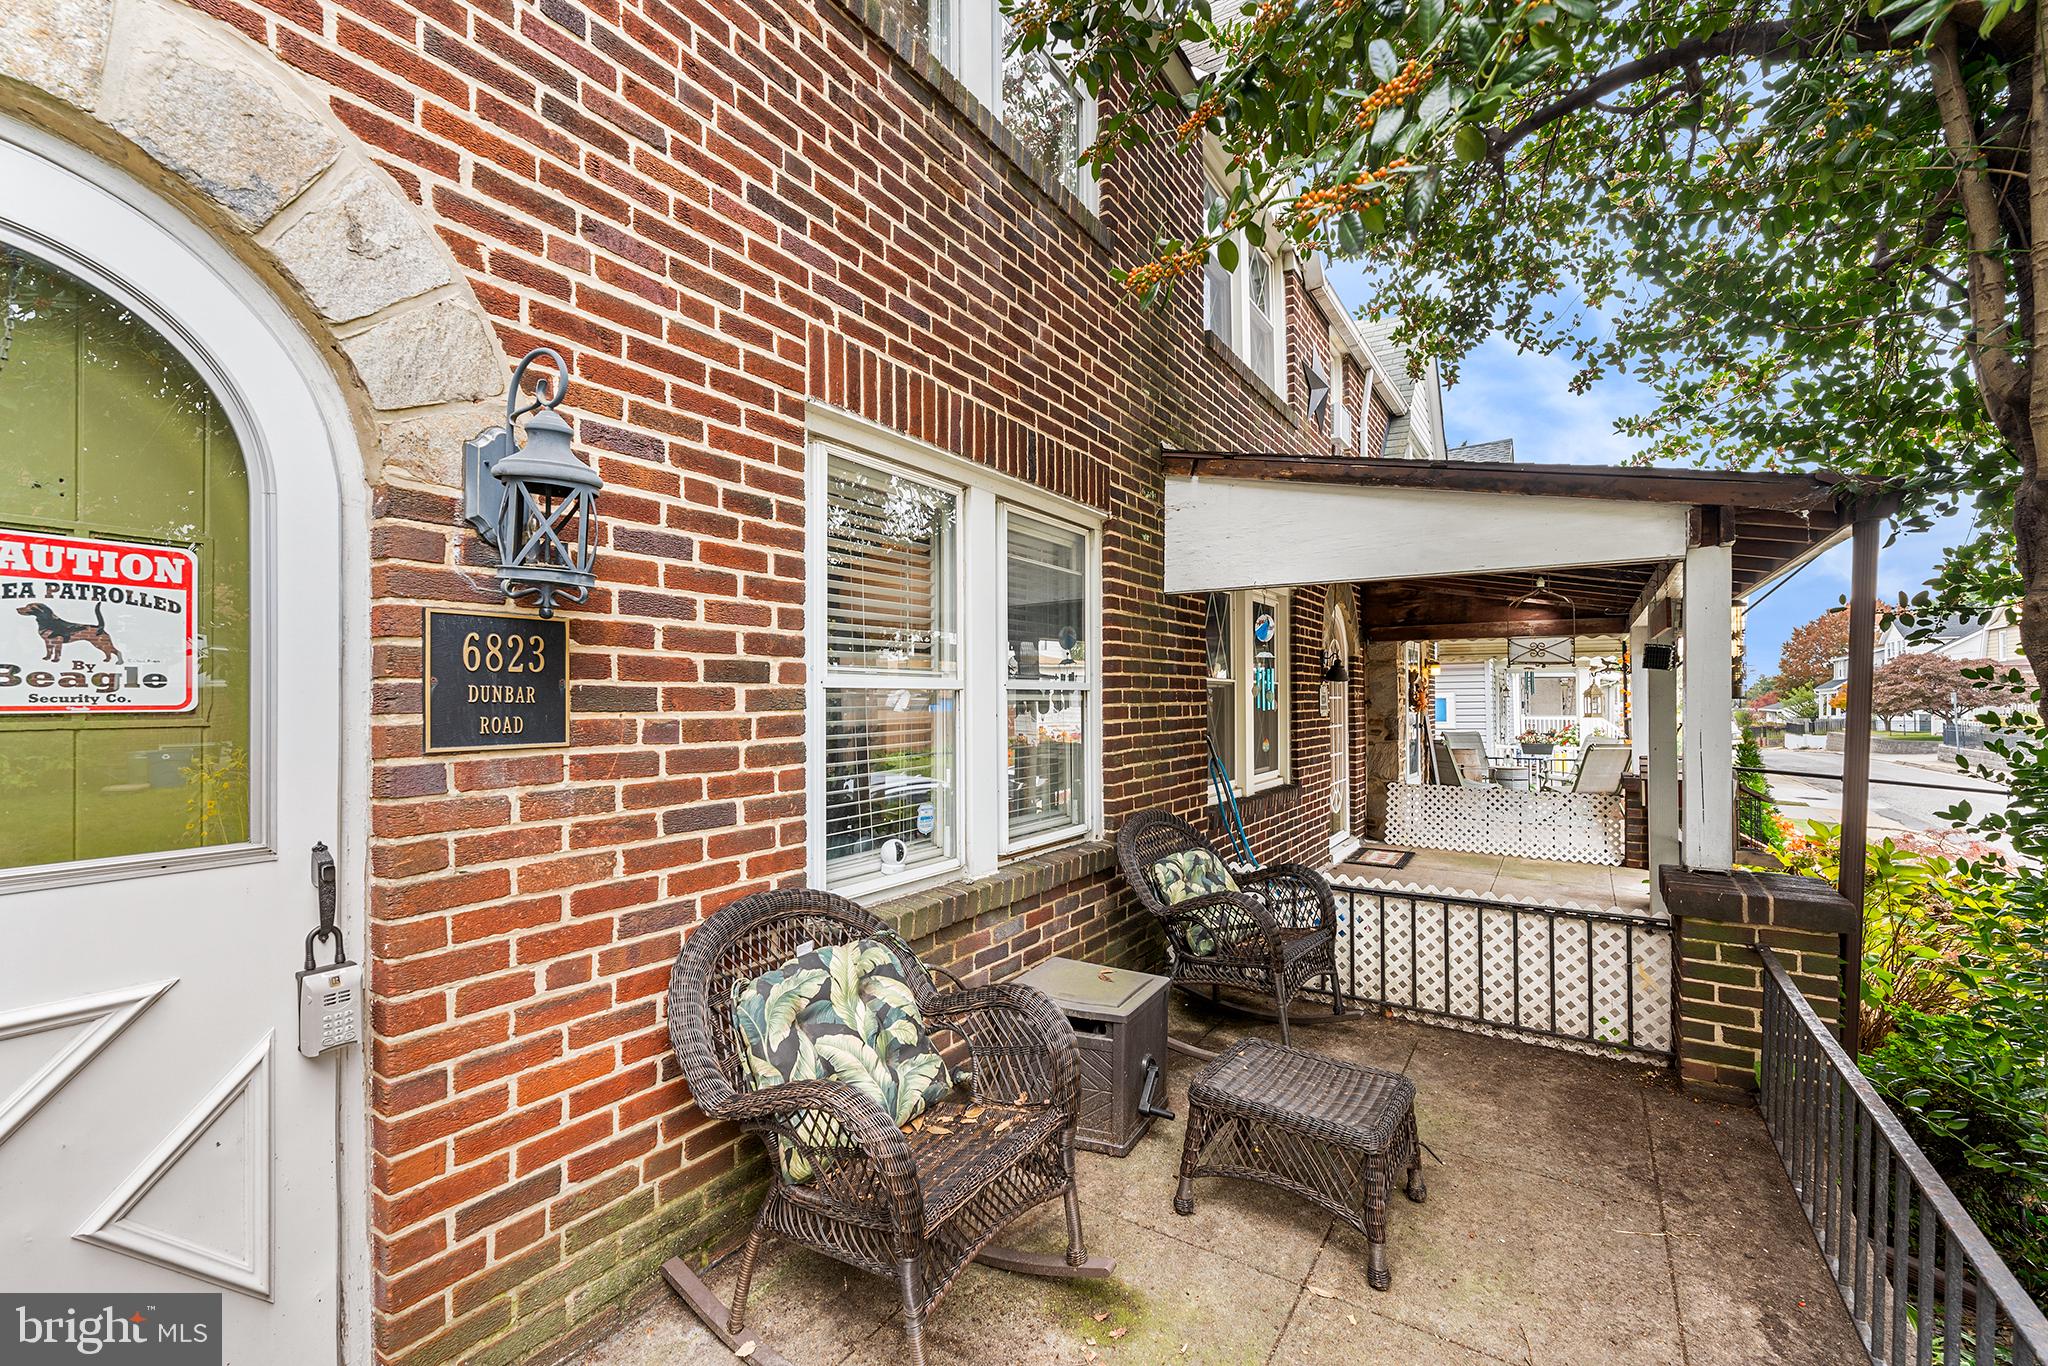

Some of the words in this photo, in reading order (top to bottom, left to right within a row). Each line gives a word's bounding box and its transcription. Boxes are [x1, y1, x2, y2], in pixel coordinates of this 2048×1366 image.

[0, 540, 185, 584] AUTION
[2, 582, 36, 599] EA
[45, 582, 182, 614] PATROLLED
[462, 632, 545, 672] 6823
[0, 664, 168, 693] Beagle
[72, 660, 96, 673] By
[28, 693, 100, 705] Security
[105, 693, 132, 703] Co.
[467, 684, 536, 704] DUNBAR
[479, 716, 524, 735] ROAD
